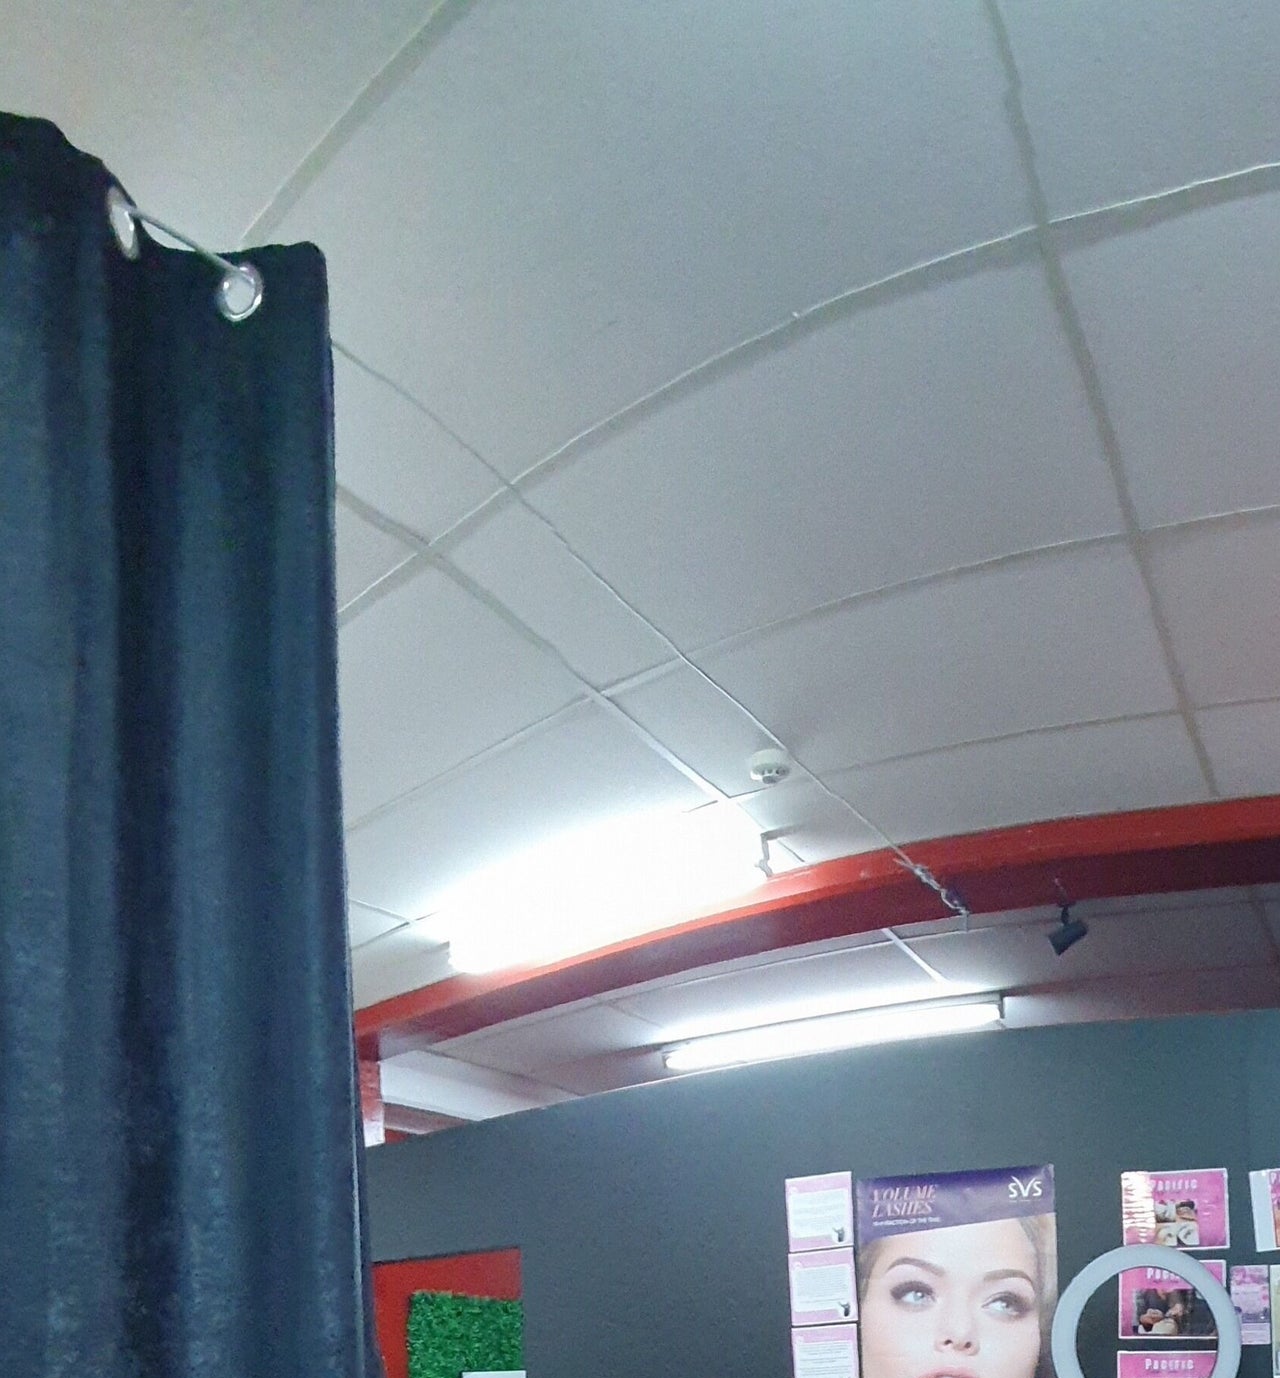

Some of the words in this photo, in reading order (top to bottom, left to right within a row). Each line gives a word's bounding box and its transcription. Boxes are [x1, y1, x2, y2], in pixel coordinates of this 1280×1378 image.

[872, 1184, 937, 1203] VOLUME
[1007, 1175, 1043, 1199] SVS
[872, 1201, 933, 1219] LASHES
